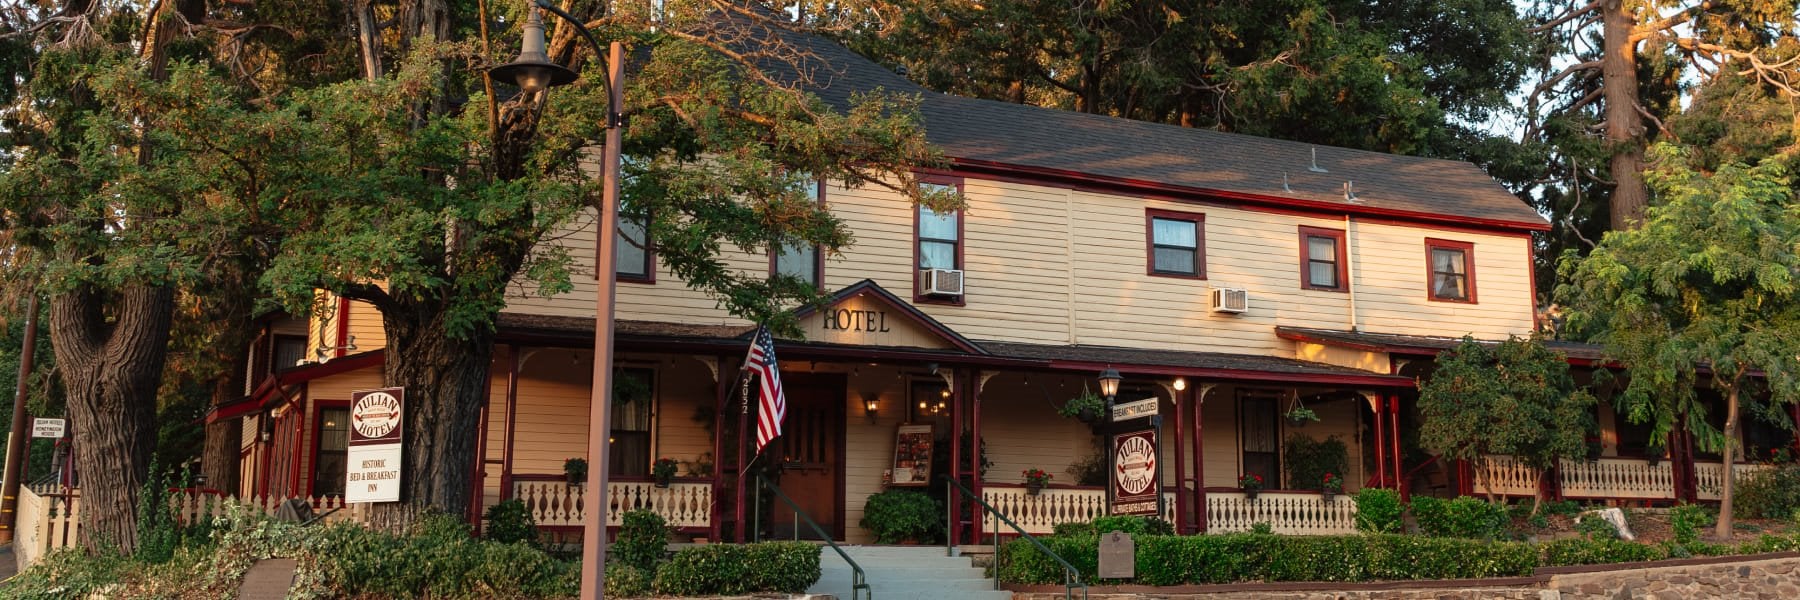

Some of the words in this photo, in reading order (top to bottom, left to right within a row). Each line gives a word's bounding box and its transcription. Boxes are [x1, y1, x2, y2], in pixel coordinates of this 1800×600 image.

[823, 307, 890, 332] HOTEL
[358, 394, 398, 414] JULIAN
[1113, 405, 1136, 418] BREAKFAST
[1136, 401, 1157, 414] INCLUDED
[358, 422, 394, 437] HOTEL
[1120, 438, 1153, 464] JULIAN
[362, 459, 386, 469] HISTORIC
[349, 472, 361, 482] BED
[361, 473, 366, 481] &
[366, 470, 398, 480] BREAKFAST
[1122, 475, 1150, 492] HOTEL
[367, 483, 378, 493] INN
